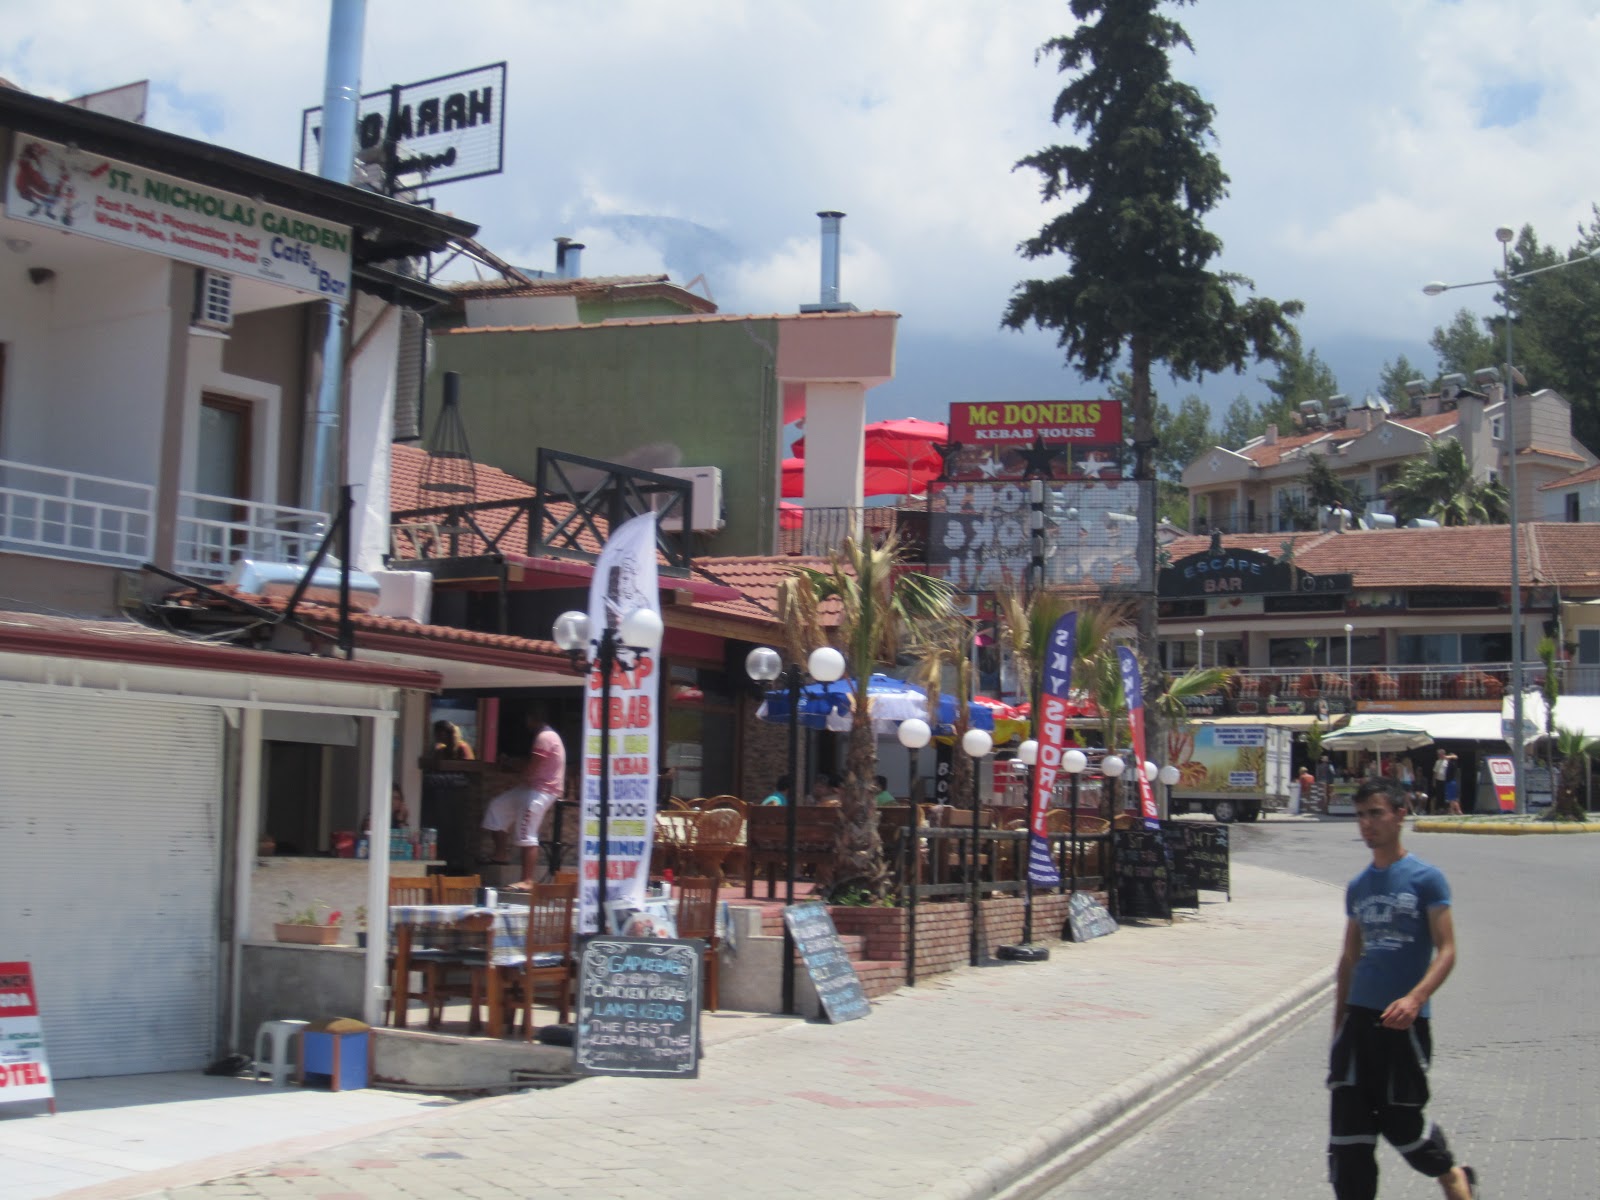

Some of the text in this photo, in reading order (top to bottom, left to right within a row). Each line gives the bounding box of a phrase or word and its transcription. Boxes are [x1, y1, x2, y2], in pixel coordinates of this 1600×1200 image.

[108, 169, 348, 252] ST. NICHOLAS GARDEN
[271, 237, 311, 266] Café
[319, 269, 346, 295] Bar
[968, 403, 1100, 425] Mc DONERS
[975, 428, 1095, 439] KEBAB HOUSE
[1184, 558, 1261, 578] ESCAPE
[1204, 577, 1242, 593] BAR
[588, 695, 651, 730] KBAB
[588, 1019, 675, 1035] THE BEST
[657, 1034, 690, 1047] THE
